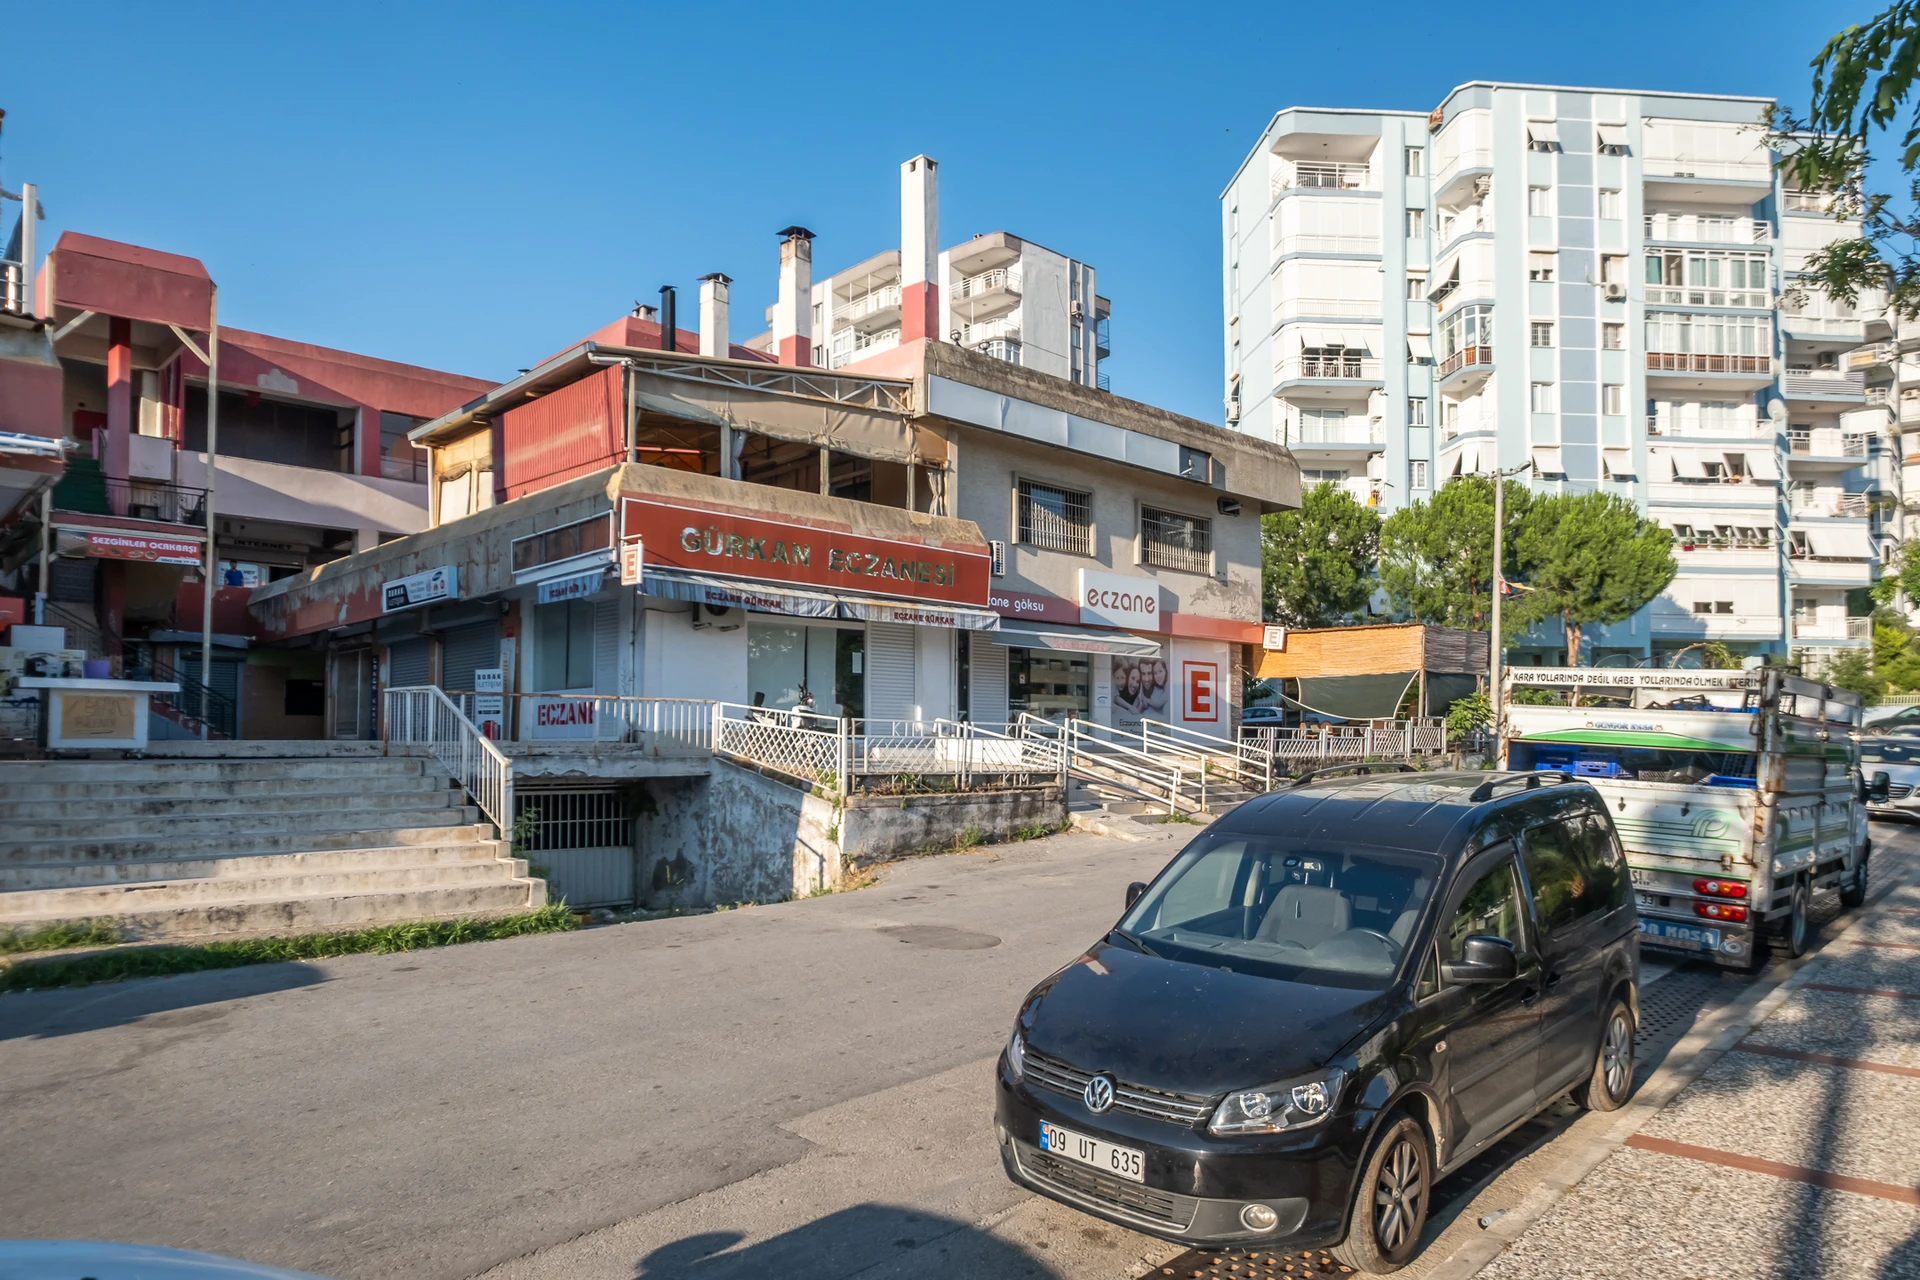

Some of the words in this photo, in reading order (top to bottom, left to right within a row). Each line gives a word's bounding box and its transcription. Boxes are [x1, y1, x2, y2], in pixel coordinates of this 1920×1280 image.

[92, 536, 146, 548] SEZGİNLER
[149, 542, 197, 554] OCAKBAŞI
[626, 553, 635, 577] E
[680, 525, 811, 567] GÜRKAN
[828, 548, 955, 587] ECZANESİ
[705, 591, 742, 604] ECZANE
[744, 596, 782, 608] GÜRKAN
[1014, 600, 1044, 613] göksu
[1087, 588, 1155, 614] eczane
[894, 612, 923, 622] ECZANE
[1269, 631, 1279, 644] E
[1514, 672, 1534, 682] KARA
[1536, 673, 1584, 683] YOLLARINDA
[1587, 673, 1610, 684] DEĞİL
[1612, 676, 1635, 685] KABE
[1640, 675, 1691, 685] YOLLARINDA
[1191, 671, 1210, 713] E
[1665, 925, 1714, 945] KASA
[1050, 1128, 1066, 1151] 09
[1079, 1138, 1097, 1162] UT
[1111, 1148, 1140, 1176] 635
